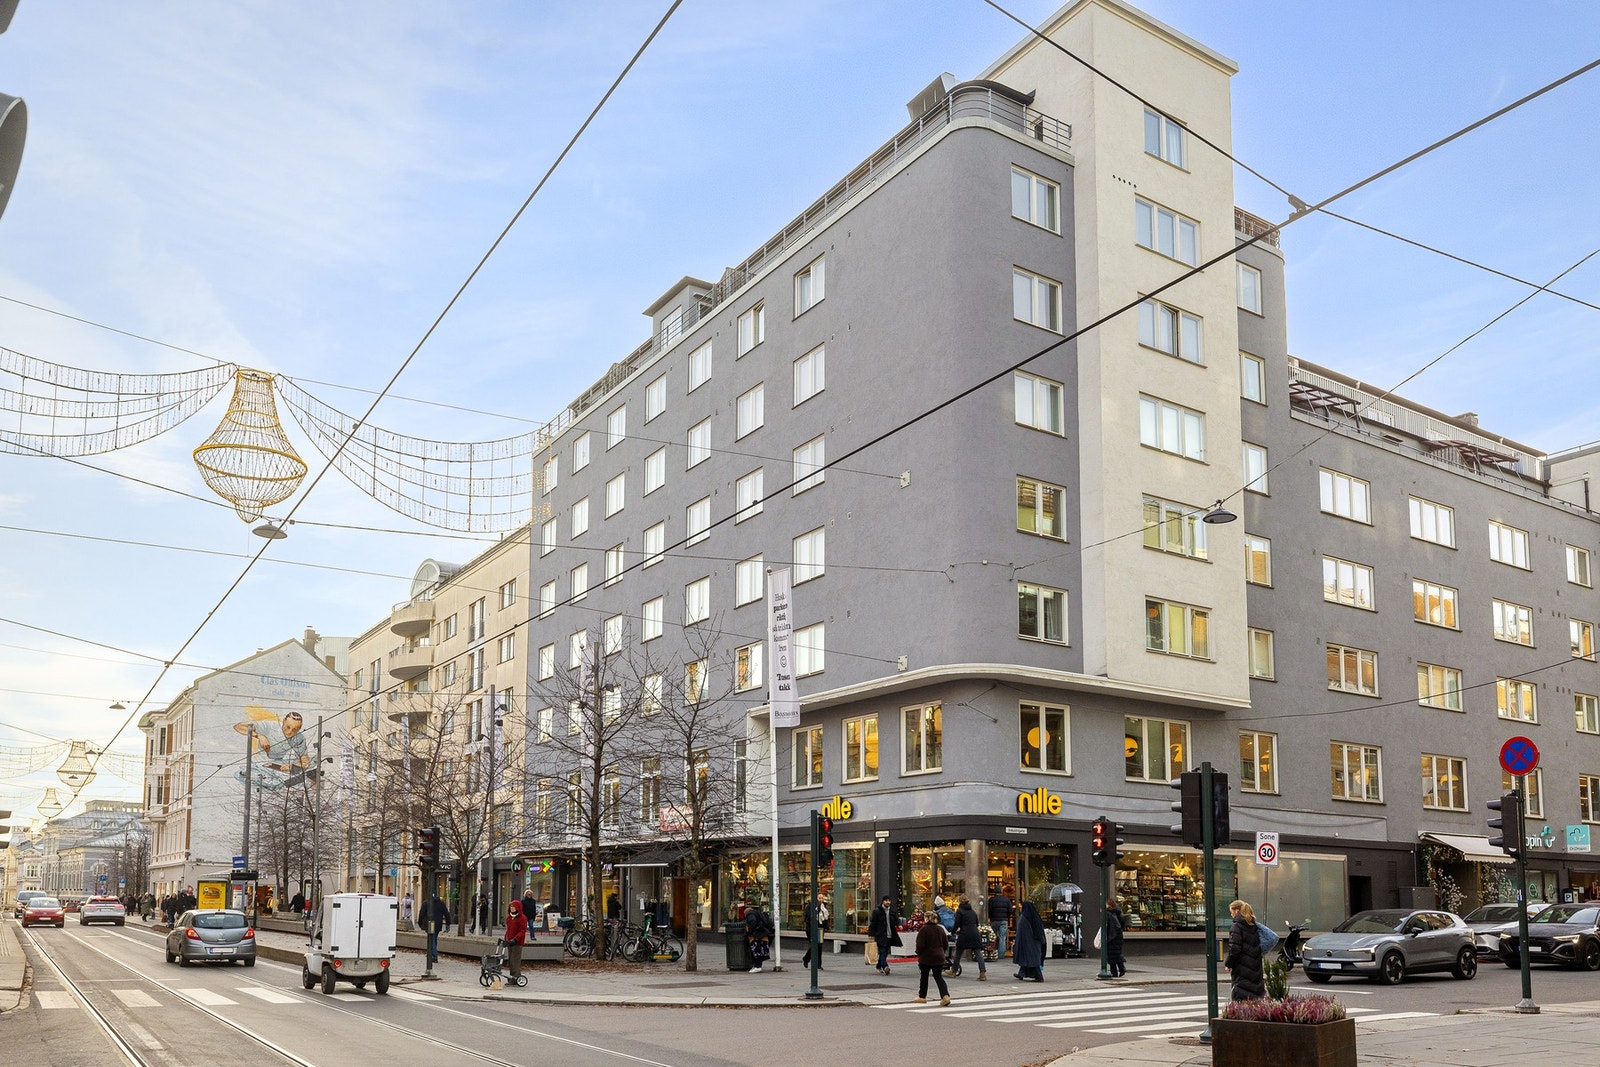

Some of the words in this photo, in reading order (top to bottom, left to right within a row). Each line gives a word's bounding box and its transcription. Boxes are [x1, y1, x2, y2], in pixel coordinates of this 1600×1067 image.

[821, 795, 852, 820] nille
[1018, 787, 1062, 815] nille
[1262, 848, 1272, 857] 30
